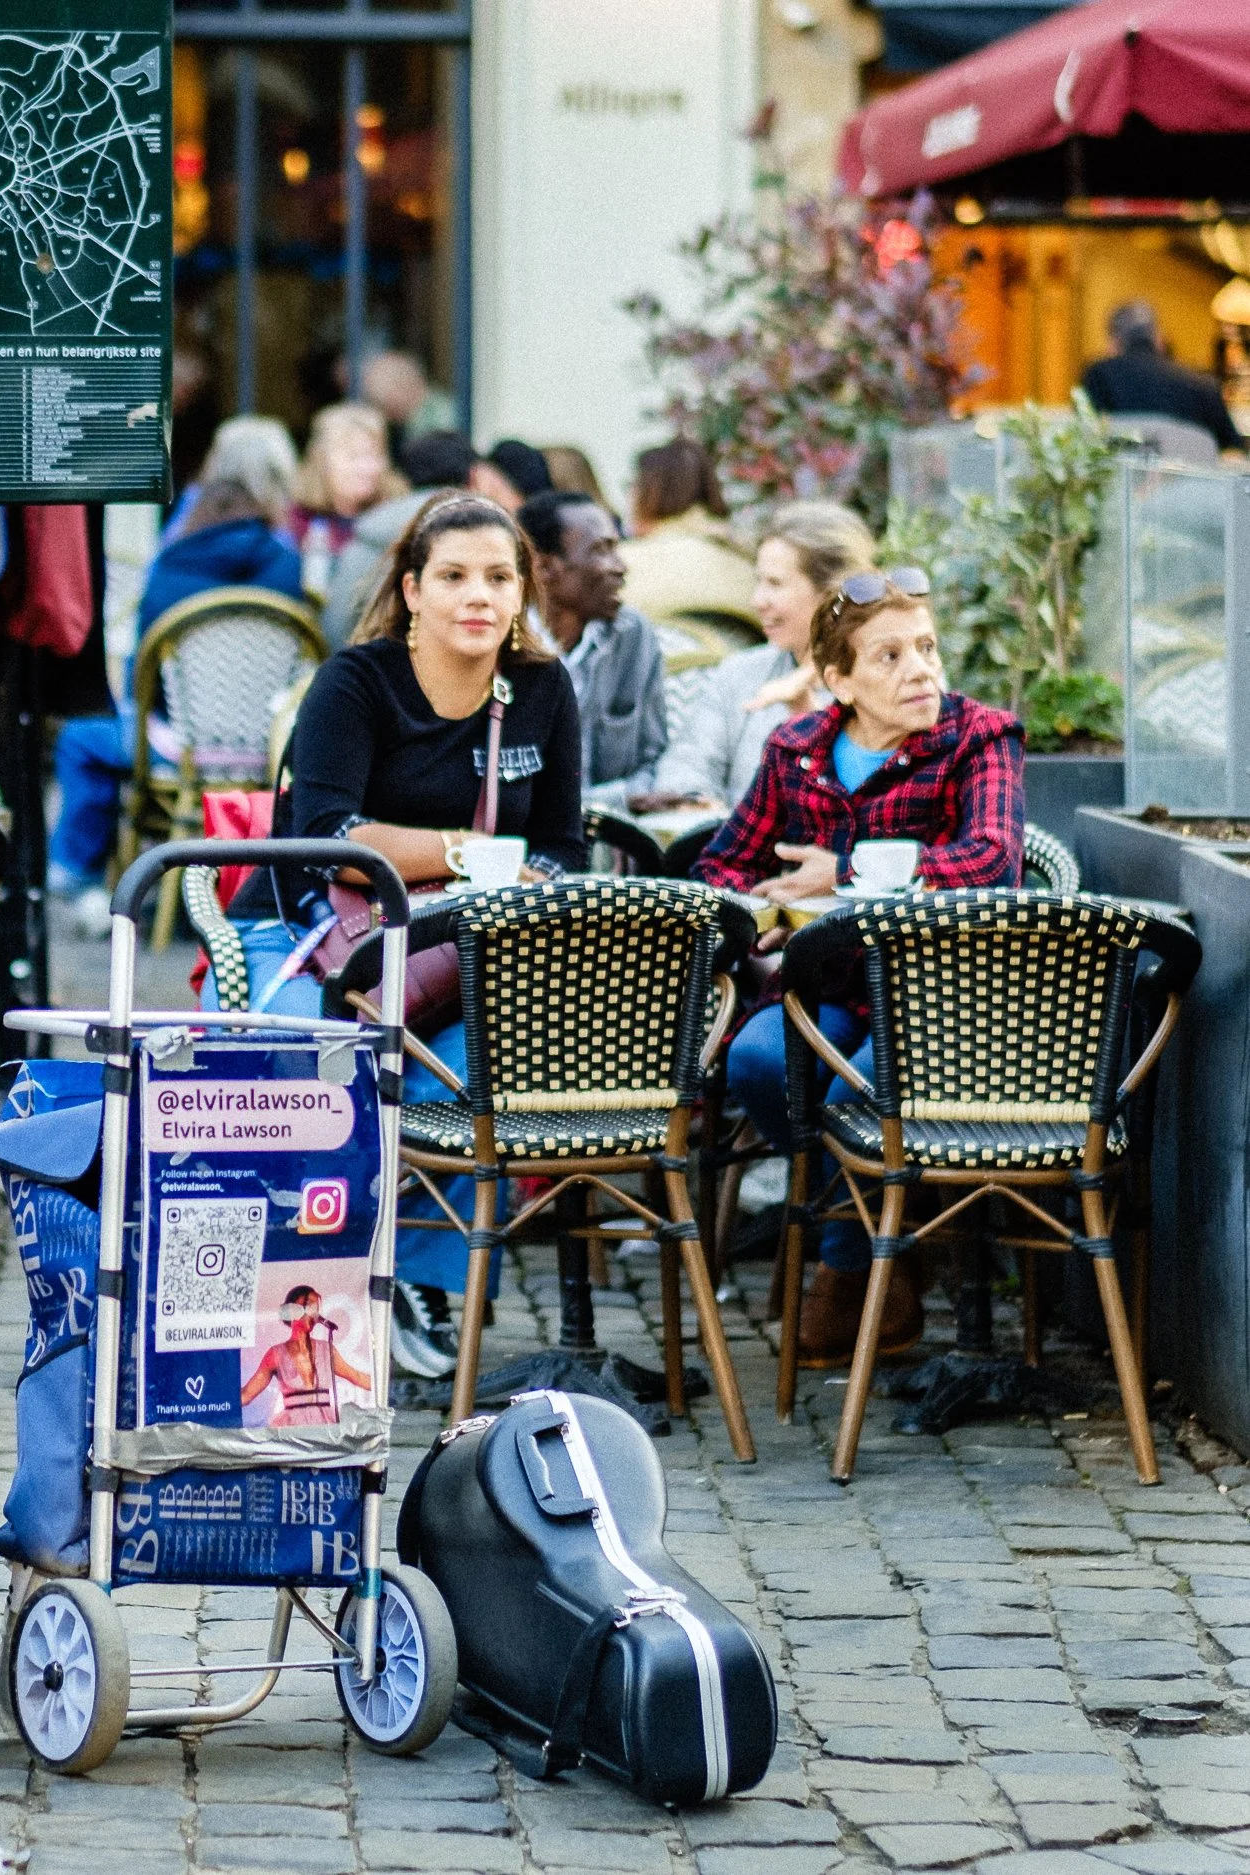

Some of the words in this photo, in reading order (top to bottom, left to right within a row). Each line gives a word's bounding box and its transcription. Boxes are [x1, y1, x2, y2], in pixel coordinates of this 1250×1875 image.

[17, 347, 32, 358] en
[36, 346, 58, 358] hun
[62, 346, 137, 359] belangrijkste
[140, 346, 161, 358] site
[157, 1088, 343, 1115] @elviralawson_
[162, 1121, 216, 1139] Elvira
[222, 1121, 292, 1138] Lawson
[161, 1169, 188, 1178] Follow
[190, 1170, 202, 1178] me
[203, 1170, 215, 1178] on
[156, 1404, 180, 1414] Thank
[181, 1404, 197, 1415] you
[197, 1404, 208, 1413] so
[208, 1402, 231, 1412] much
